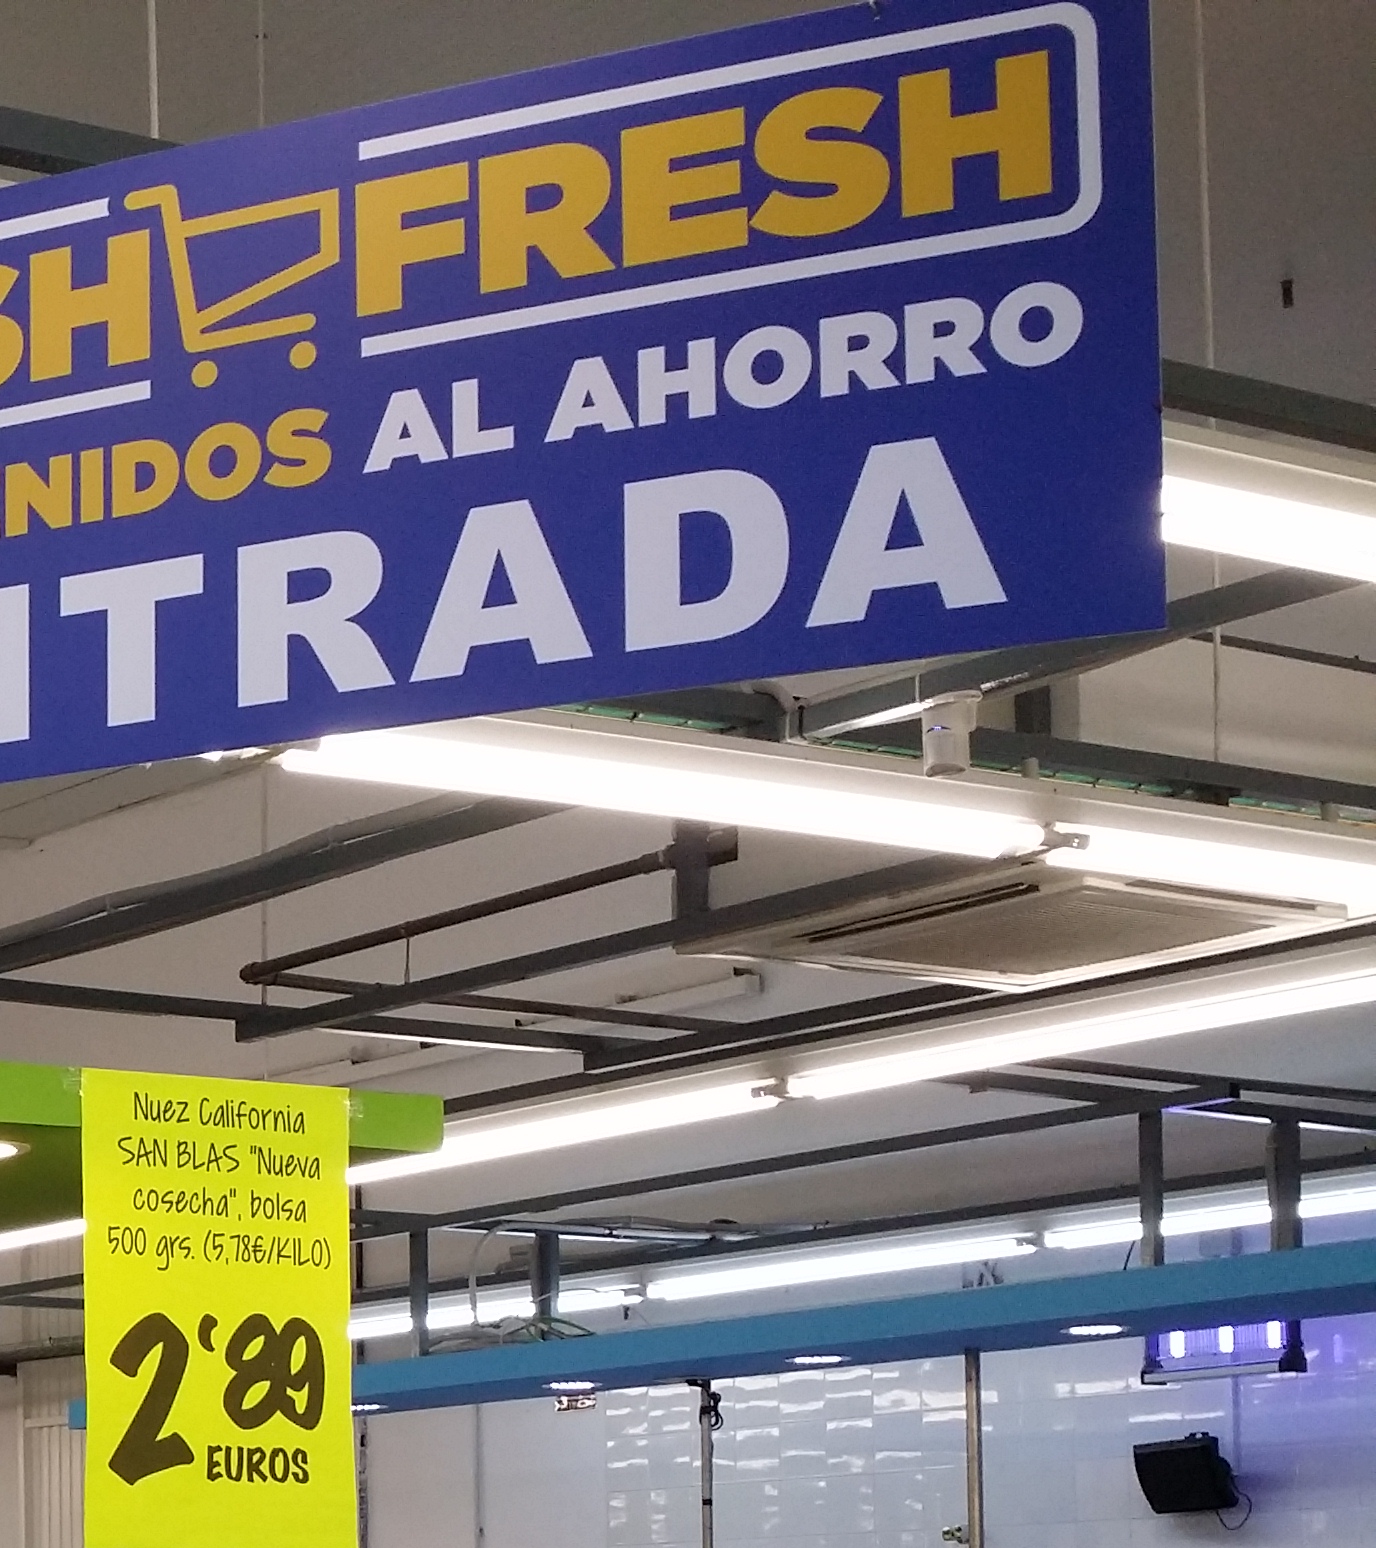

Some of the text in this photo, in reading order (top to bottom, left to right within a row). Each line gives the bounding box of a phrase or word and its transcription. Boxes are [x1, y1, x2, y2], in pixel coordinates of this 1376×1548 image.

[356, 50, 1049, 319] FRESH
[363, 385, 514, 472] AL
[544, 281, 1083, 445] AHORRO
[134, 1091, 306, 1135] Nuez California
[117, 1137, 320, 1180] SAN BLAS "Nueva
[250, 1190, 307, 1223] bolsa
[107, 1227, 146, 1256] 500
[156, 1231, 195, 1270] grs.
[207, 1445, 309, 1484] EUROS
